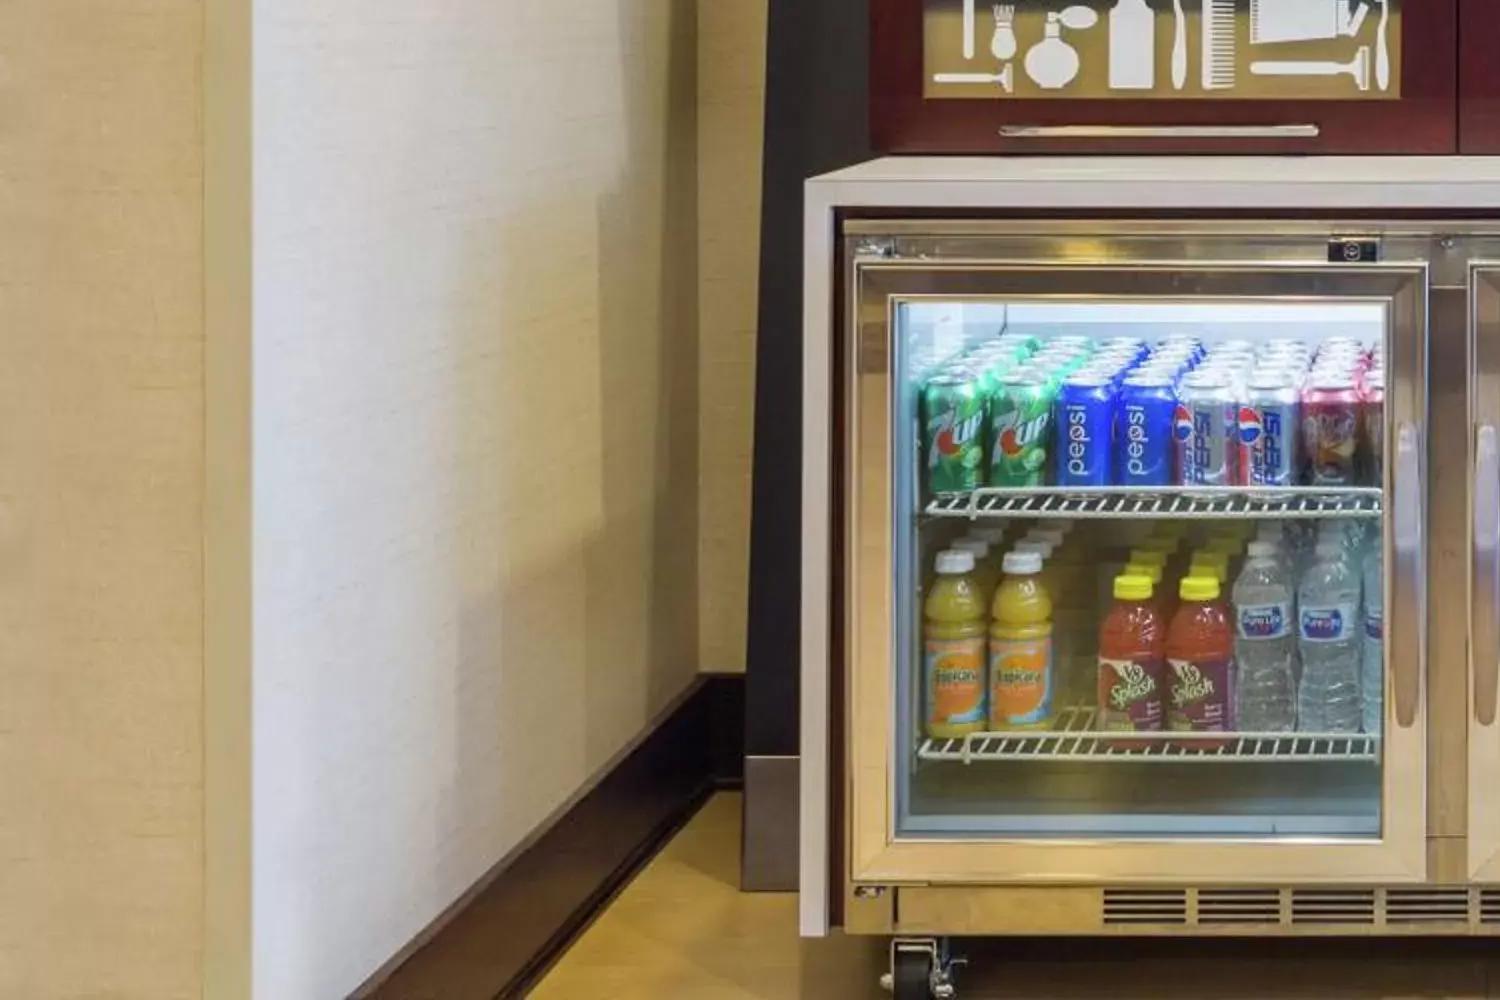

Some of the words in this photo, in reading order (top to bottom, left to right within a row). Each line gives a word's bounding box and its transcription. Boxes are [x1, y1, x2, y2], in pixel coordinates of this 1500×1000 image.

[1066, 404, 1091, 476] pepsi
[1125, 404, 1149, 476] pepsi
[1109, 674, 1156, 710] Splash
[1170, 677, 1216, 708] Splash
